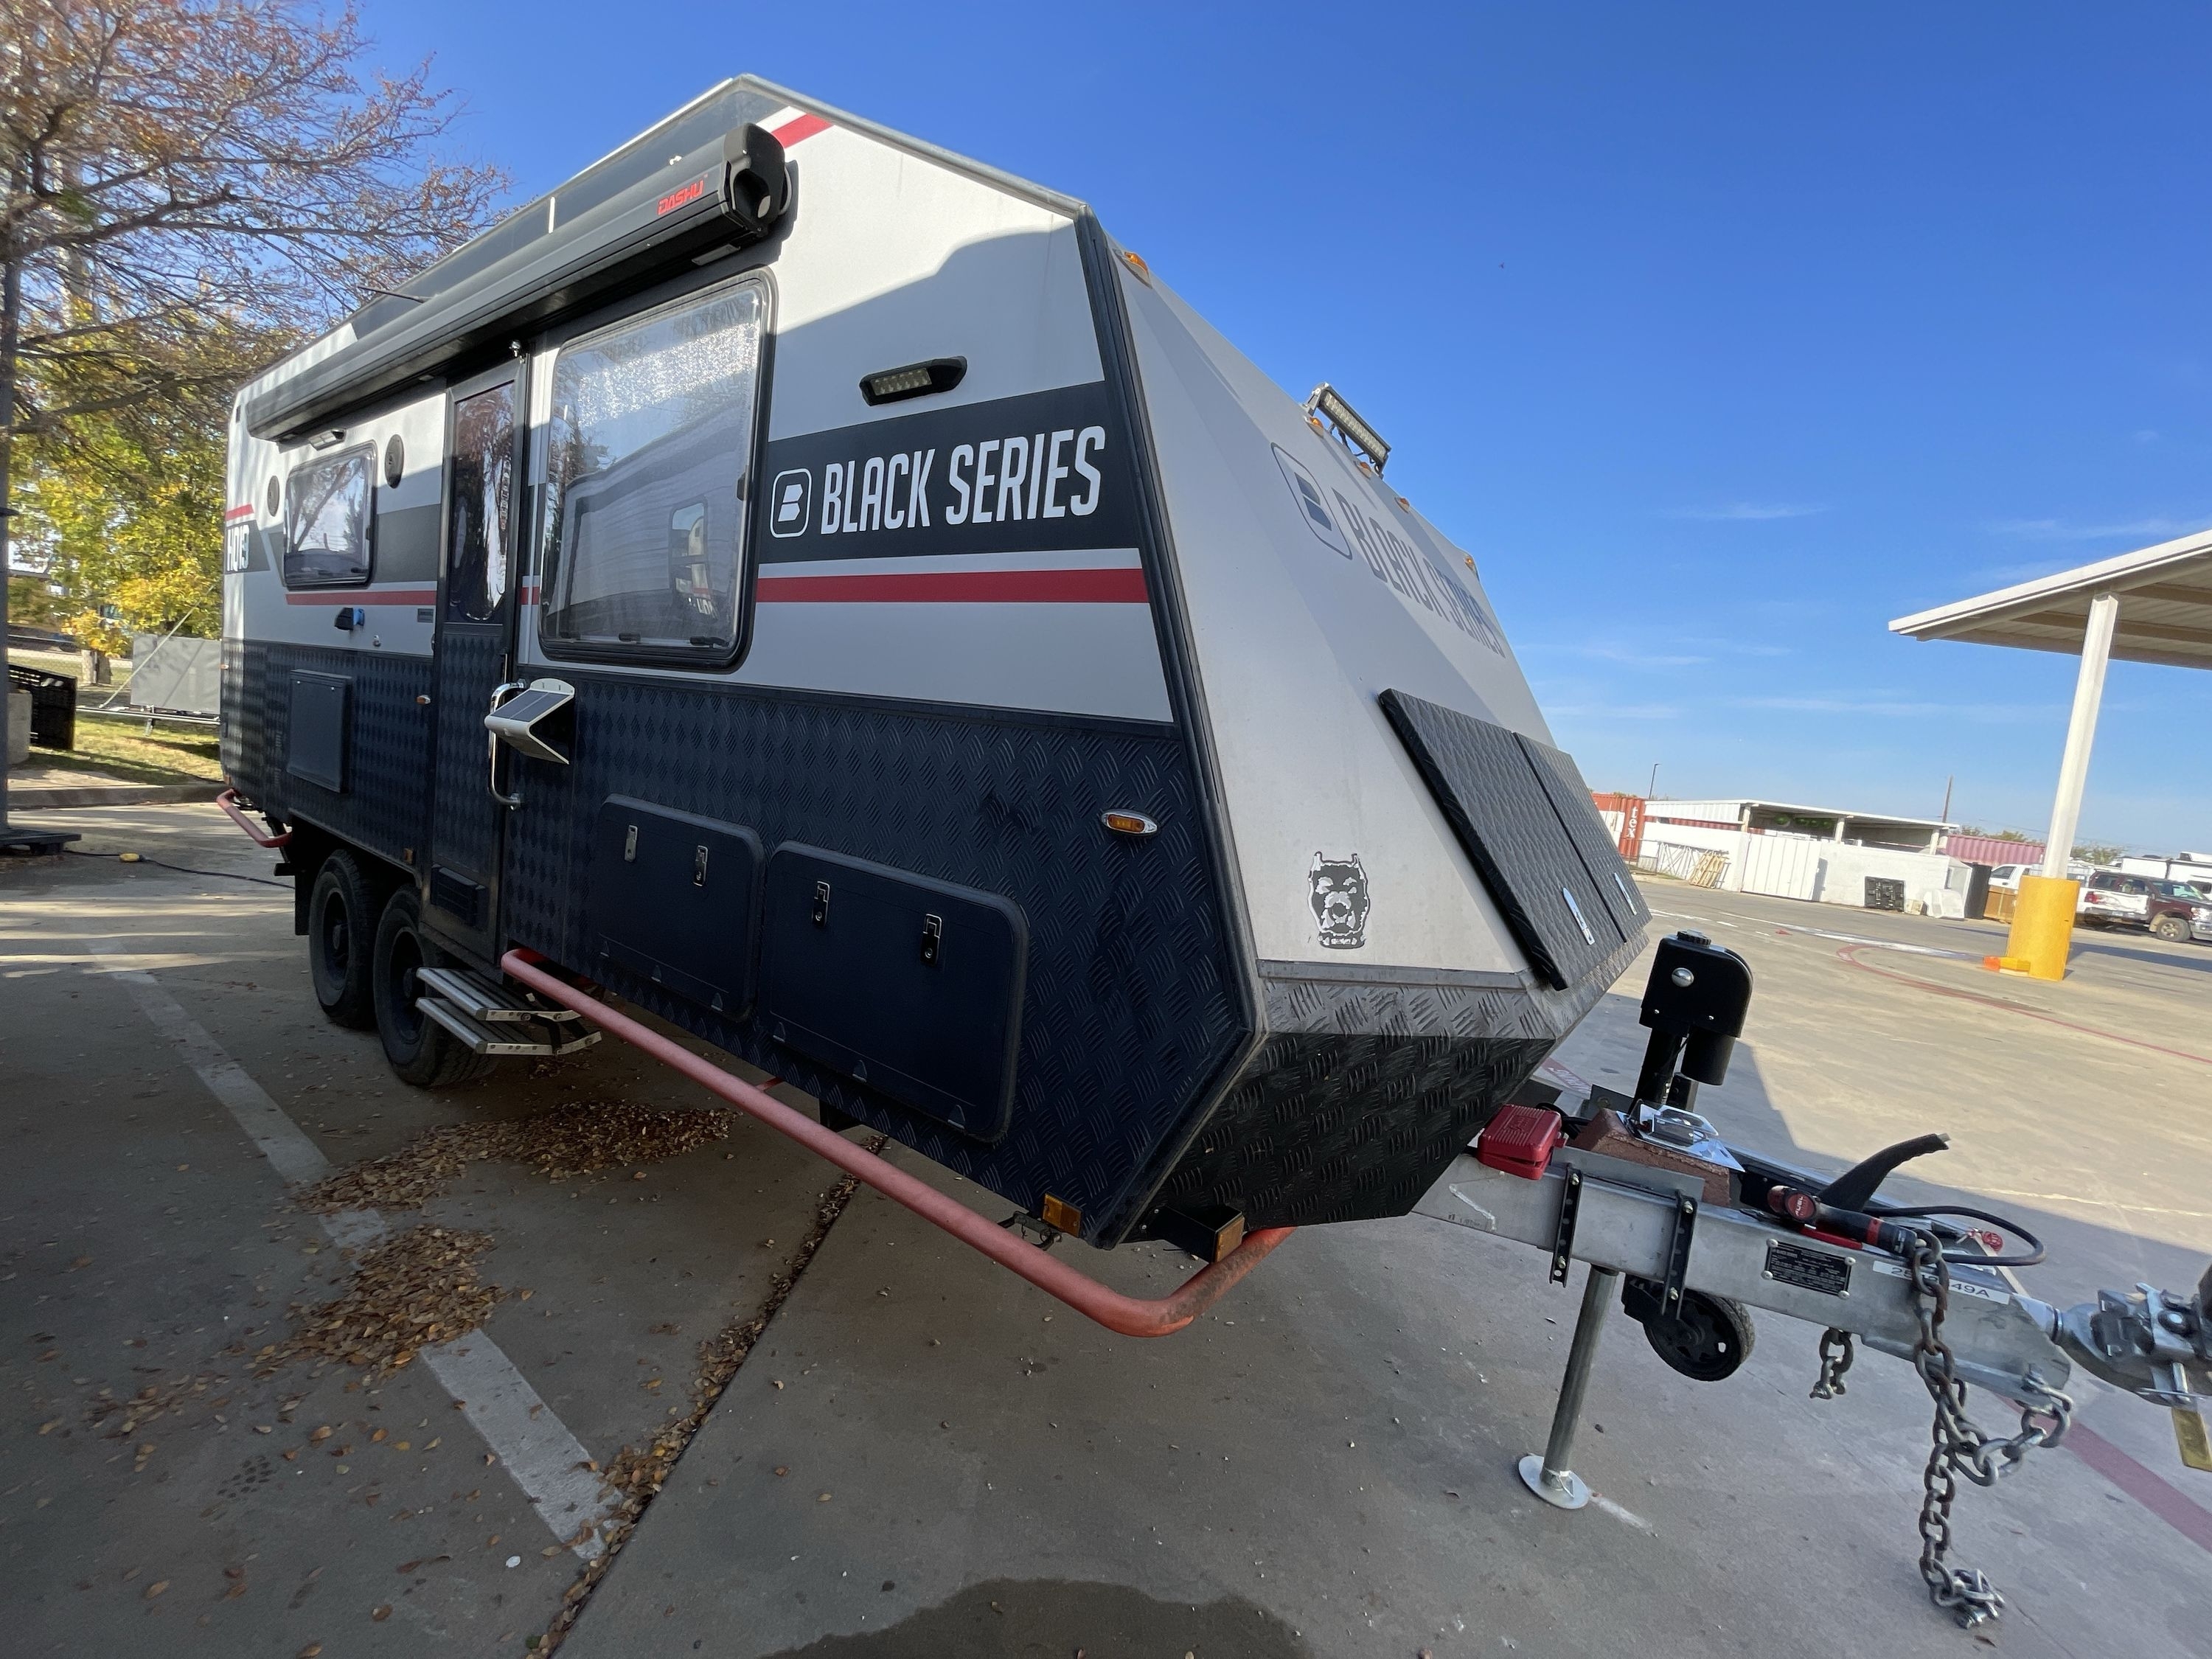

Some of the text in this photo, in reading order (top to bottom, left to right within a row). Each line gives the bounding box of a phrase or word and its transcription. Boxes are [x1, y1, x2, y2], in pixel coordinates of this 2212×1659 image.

[658, 179, 703, 215] DASHU
[821, 448, 936, 535] BLACK
[945, 425, 1106, 525] SERIES
[1331, 487, 1450, 622] BLACK
